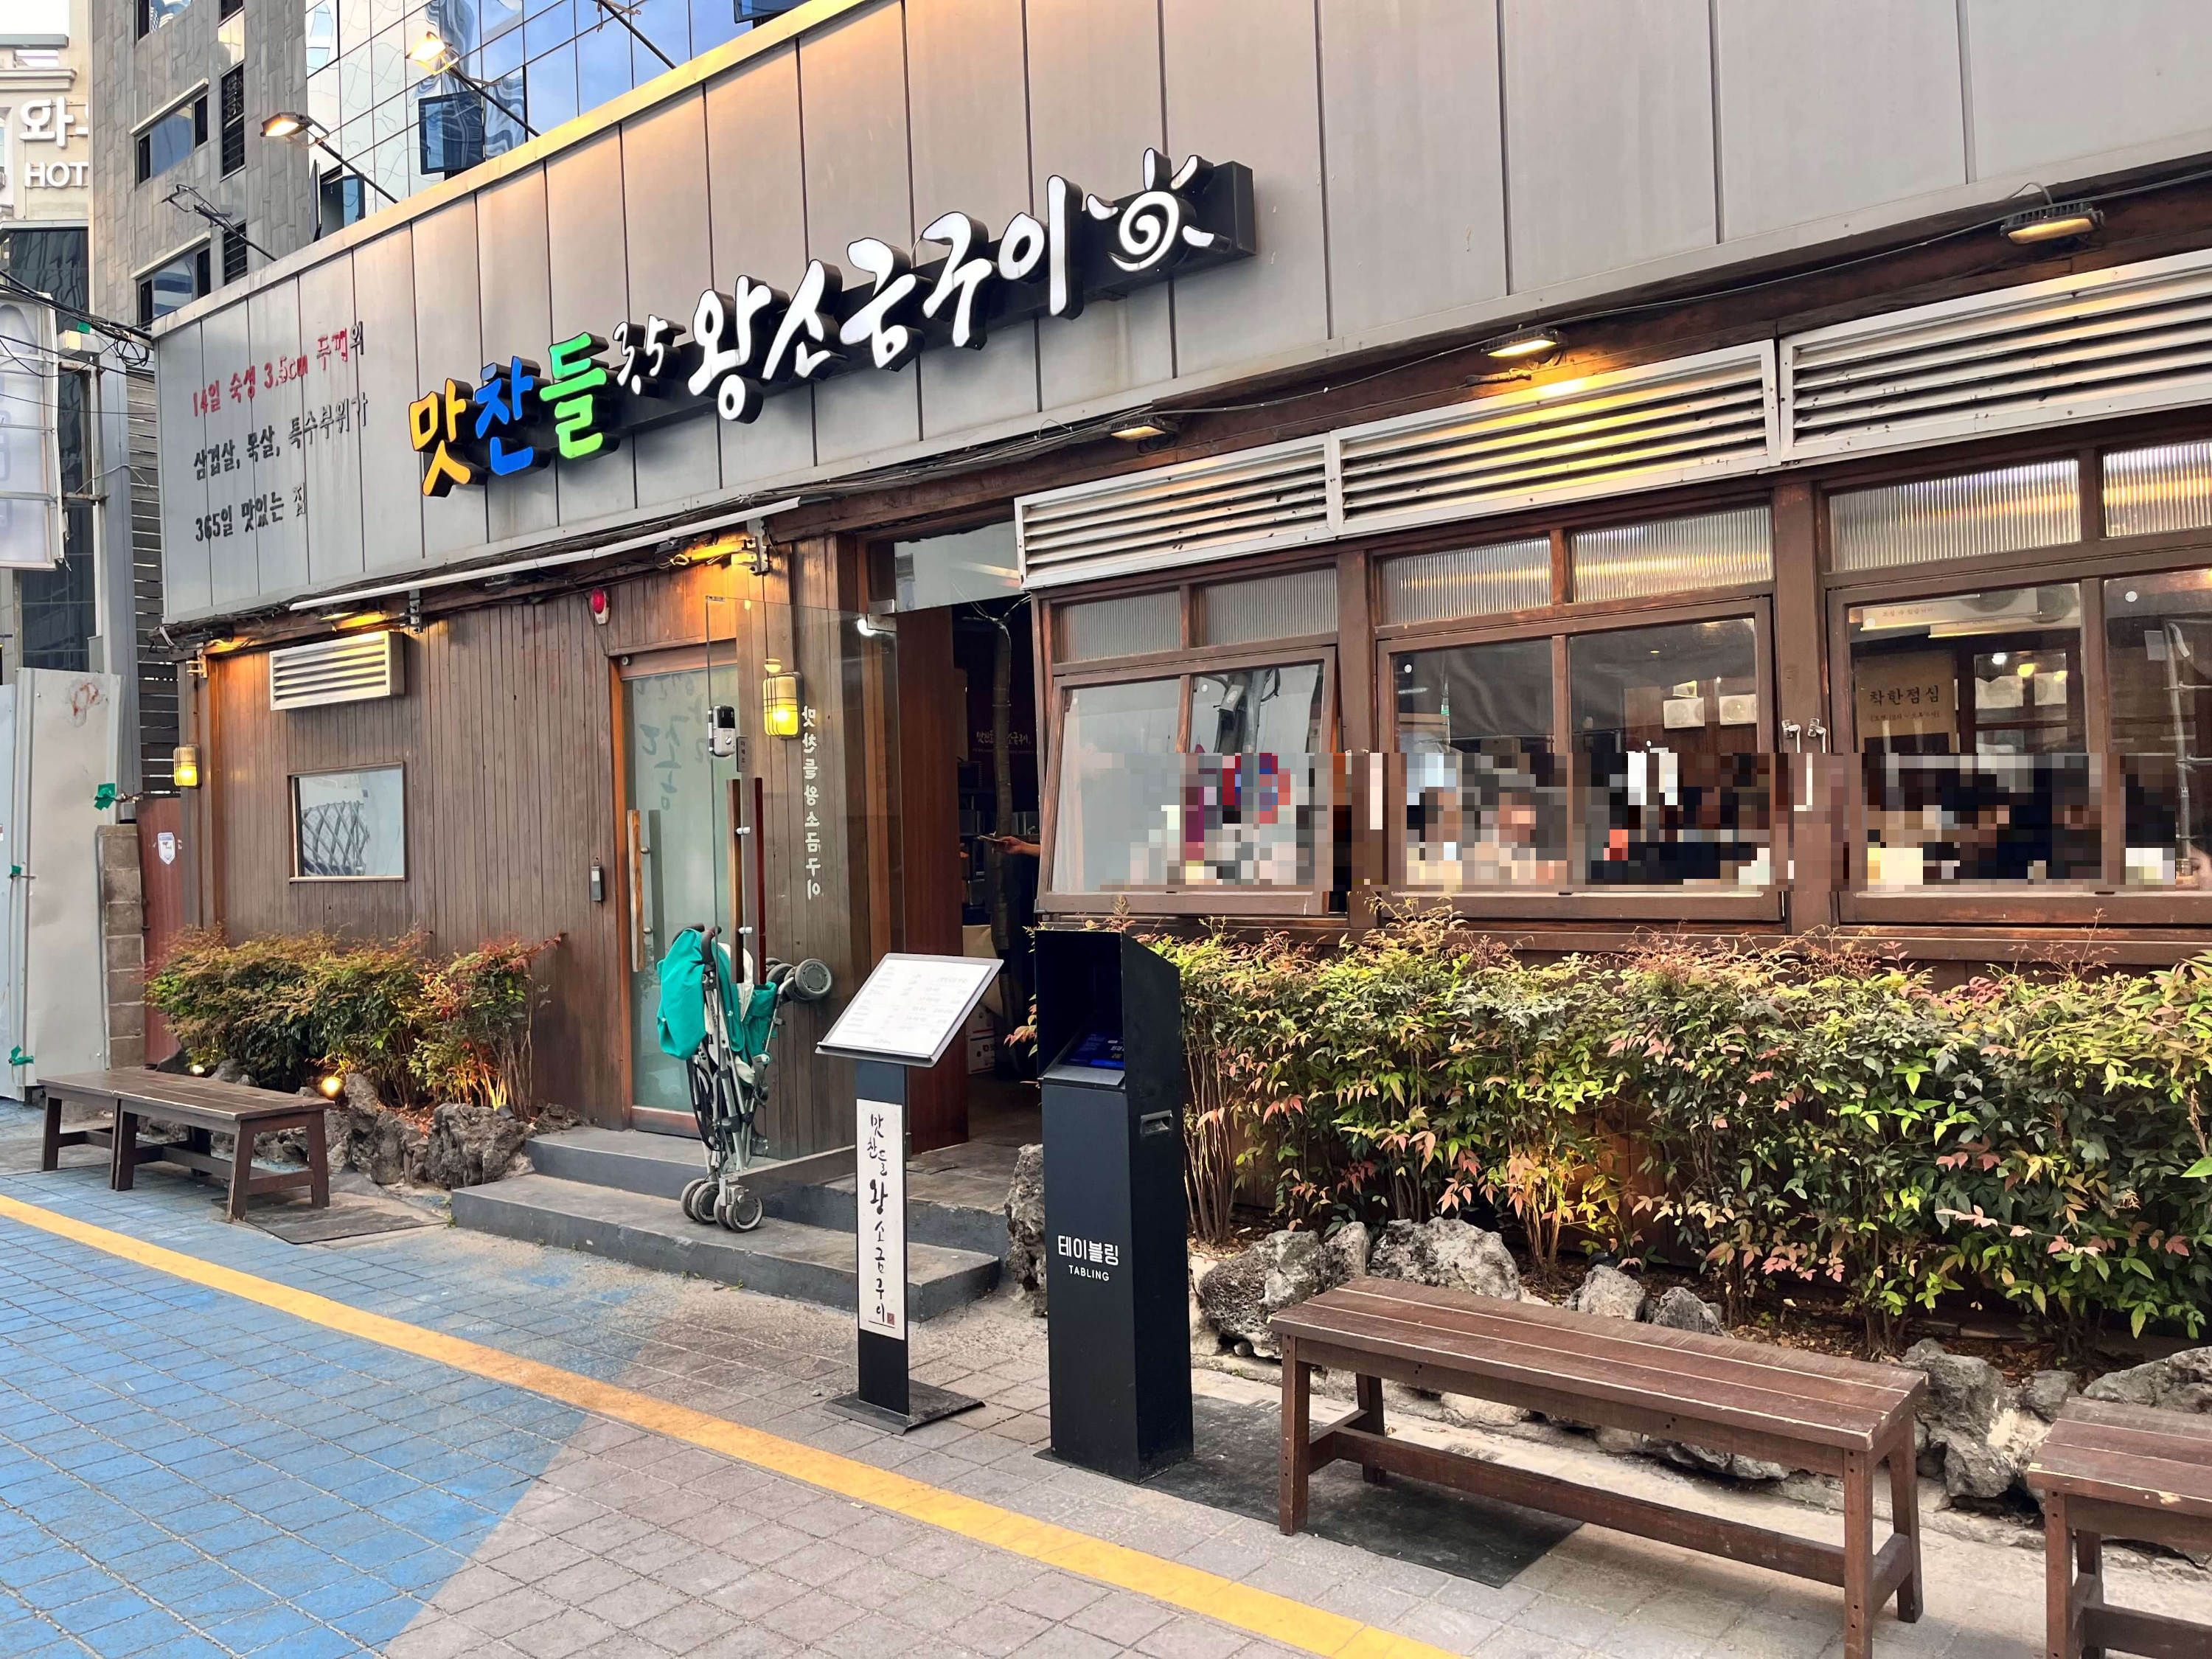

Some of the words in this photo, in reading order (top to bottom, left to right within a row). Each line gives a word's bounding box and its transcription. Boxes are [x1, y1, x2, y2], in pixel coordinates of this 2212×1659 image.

[18, 96, 88, 148] 와
[408, 332, 612, 498] 맛찬들
[687, 174, 1074, 421] 왕소금구이
[192, 380, 221, 417] 14일
[229, 366, 257, 404] 숙성
[193, 439, 240, 481] 삼겹살,
[246, 425, 280, 462] 목살,
[288, 392, 369, 449] 특수부위가
[195, 505, 234, 542] 365일
[241, 492, 285, 533] 맛있는
[292, 482, 306, 517] 집
[1057, 1234, 1119, 1266] 테이블링
[1068, 1265, 1110, 1281] TABLING
